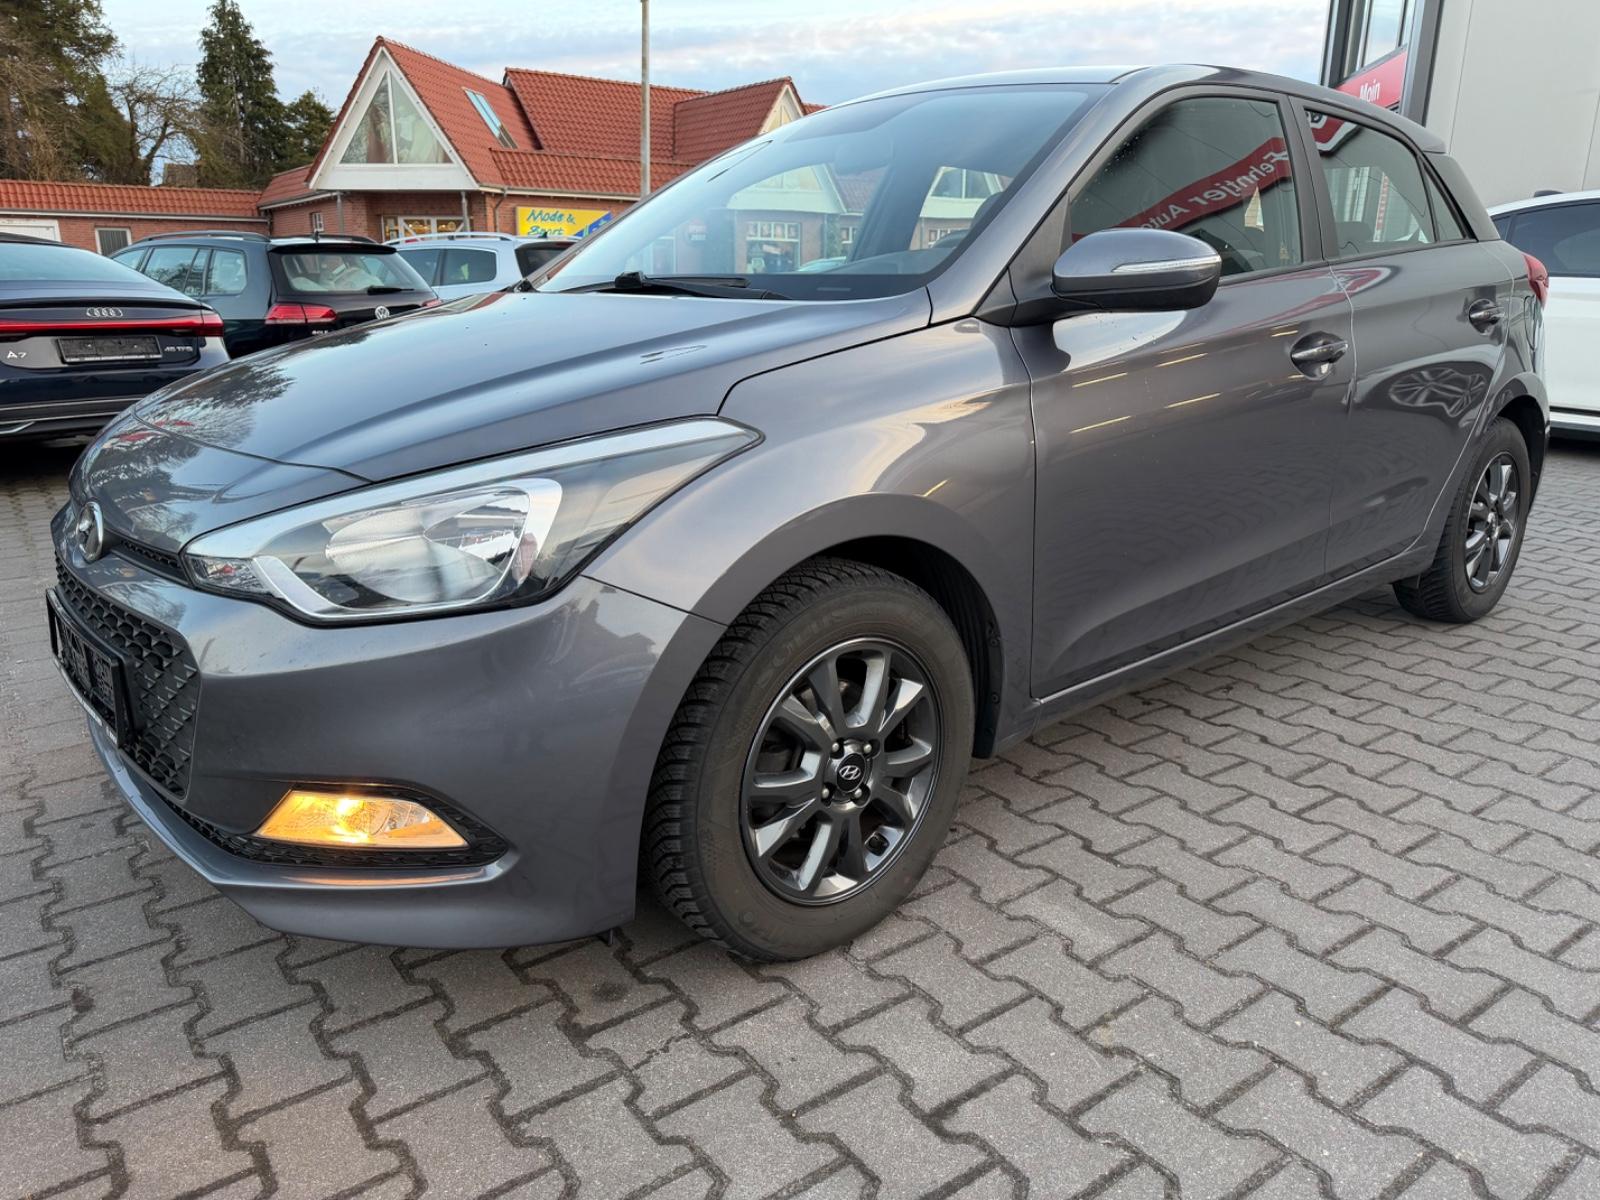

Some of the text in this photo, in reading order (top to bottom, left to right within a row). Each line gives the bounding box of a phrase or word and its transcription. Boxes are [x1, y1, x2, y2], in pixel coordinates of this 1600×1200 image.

[1360, 79, 1380, 102] Moin
[526, 209, 576, 224] Mode &
[7, 350, 27, 359] A7
